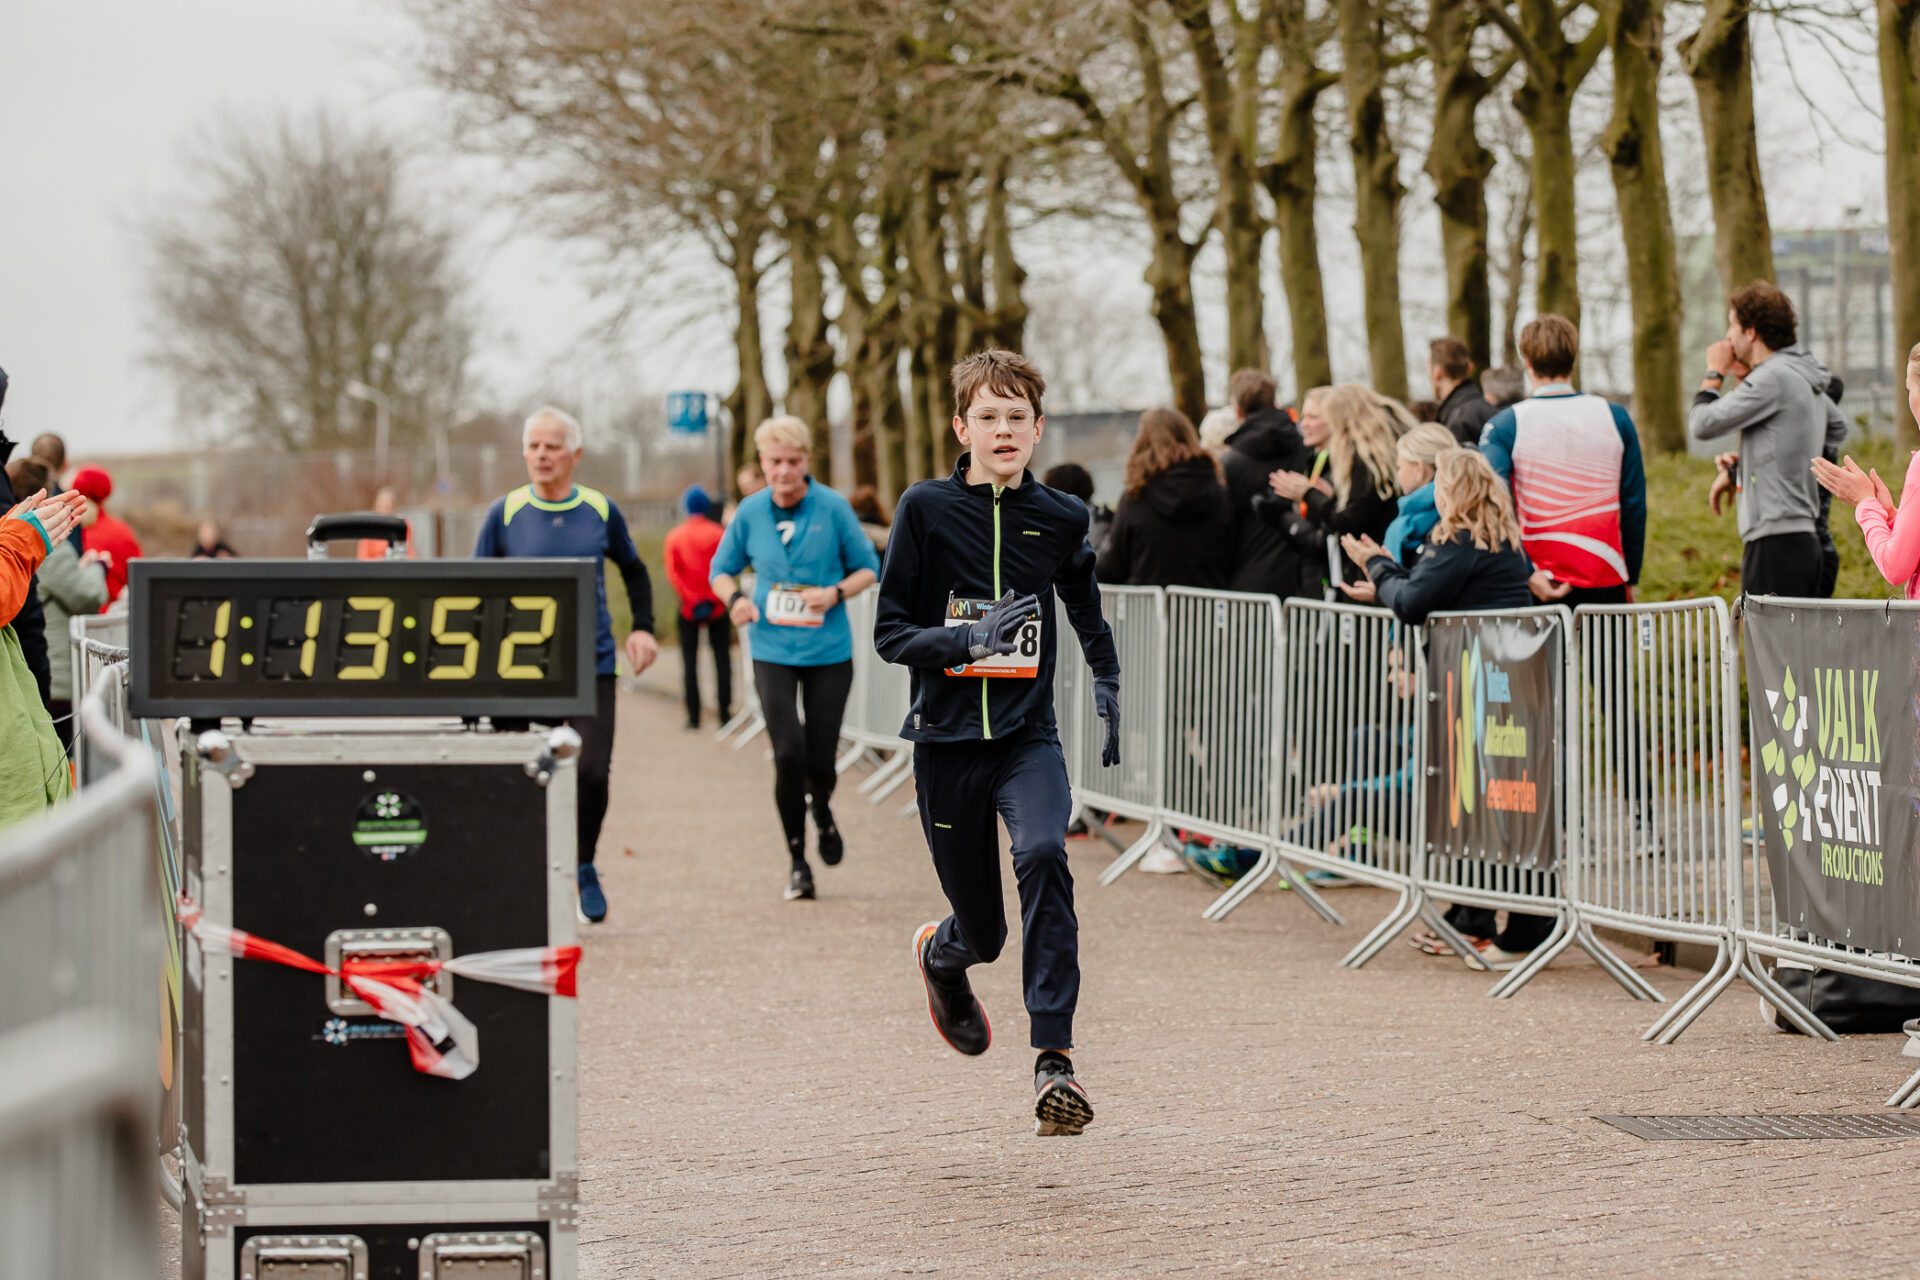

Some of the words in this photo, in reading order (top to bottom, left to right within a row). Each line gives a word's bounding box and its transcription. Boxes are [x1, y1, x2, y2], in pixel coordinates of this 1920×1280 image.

[209, 596, 557, 680] 1:13:52
[1814, 667, 1880, 763] VALK
[1485, 769, 1536, 813] eeuwarden
[1814, 765, 1882, 846] EVENT
